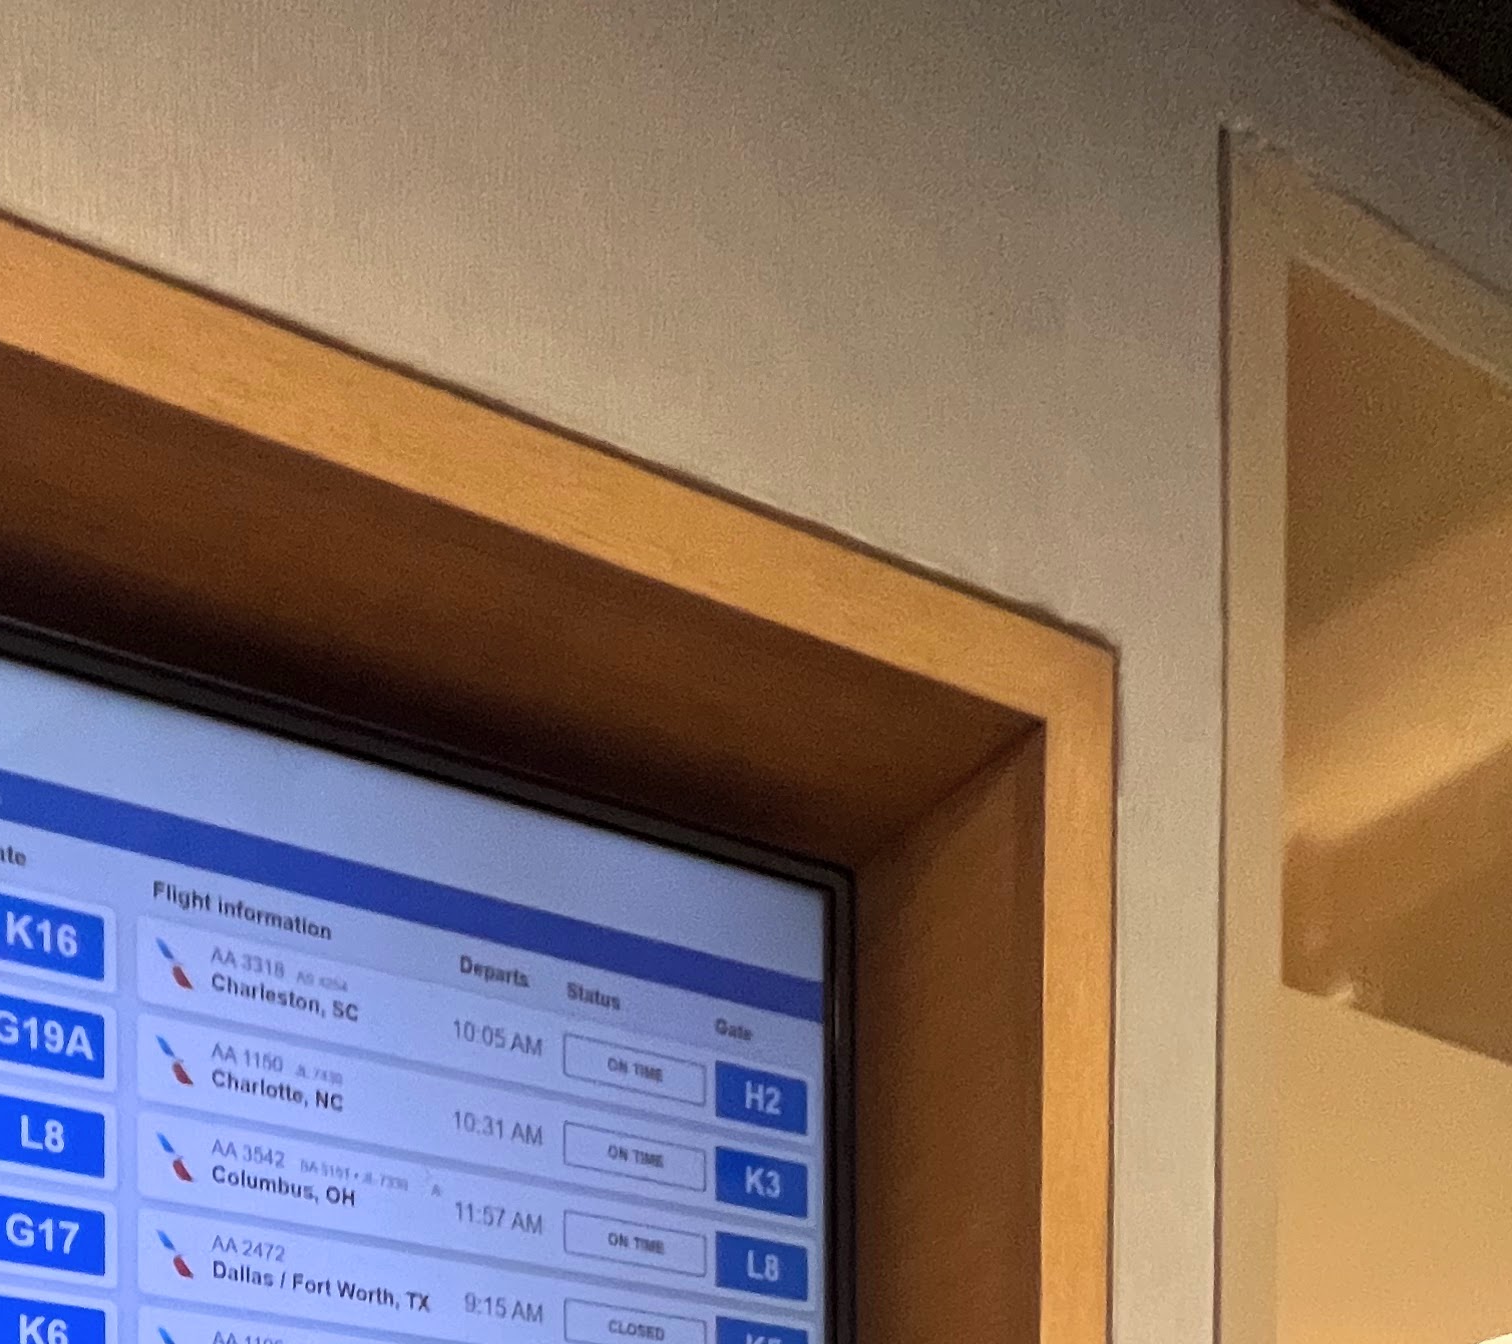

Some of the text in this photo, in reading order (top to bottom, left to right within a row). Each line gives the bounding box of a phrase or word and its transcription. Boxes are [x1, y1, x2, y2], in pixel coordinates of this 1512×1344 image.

[152, 879, 332, 941] Flight information
[5, 911, 78, 958] K16
[211, 946, 238, 969] AA
[460, 954, 530, 989] Departs
[211, 973, 326, 1019] Charleston,
[333, 1002, 359, 1022] SC
[567, 981, 621, 1011] Status
[454, 1019, 543, 1056] 10:05 AM
[714, 1017, 753, 1042] Gate
[212, 1042, 238, 1066] AA
[212, 1069, 309, 1108] Charlotte,
[315, 1089, 344, 1112] NC
[744, 1080, 782, 1117] H2
[20, 1114, 65, 1154] L8
[454, 1111, 543, 1146] 10:31 AM
[212, 1139, 286, 1169] AA 3542
[212, 1165, 319, 1203] Columbus,
[326, 1186, 356, 1207] OH
[744, 1166, 782, 1199] K3
[5, 1214, 80, 1256] G17
[455, 1201, 543, 1235] 11:57 AM
[212, 1234, 286, 1262] AA 2472
[746, 1250, 780, 1282] L8
[213, 1260, 274, 1288] Dallas
[292, 1273, 331, 1296] Fort
[337, 1281, 399, 1310] Worth,
[406, 1292, 430, 1312] TX
[465, 1294, 543, 1324] 9:15 AM
[608, 1319, 665, 1342] CLOSED
